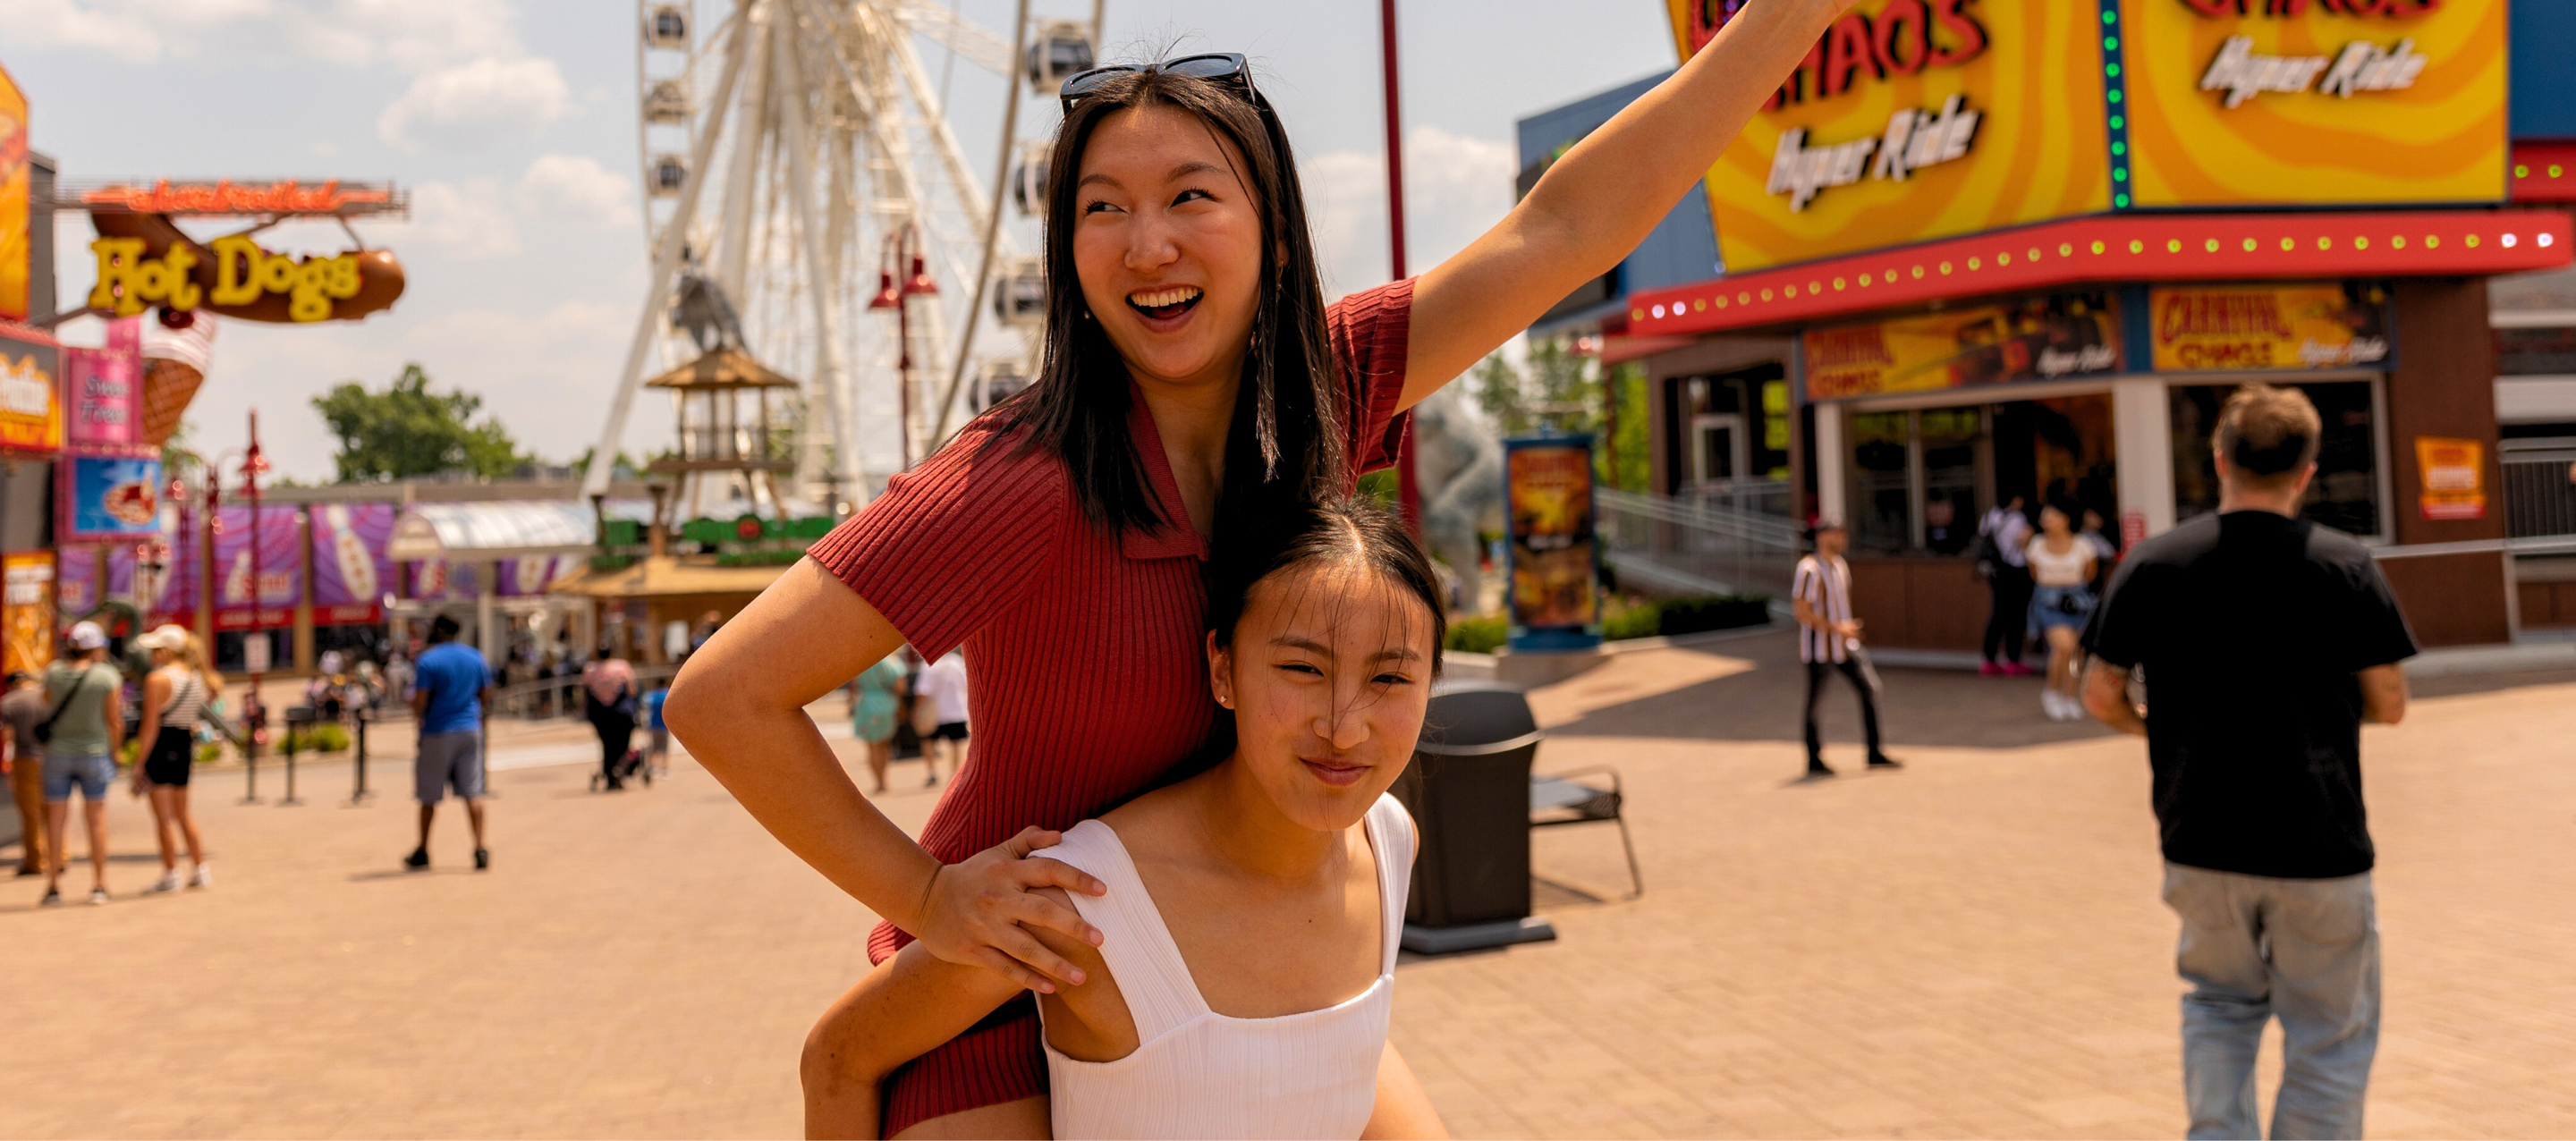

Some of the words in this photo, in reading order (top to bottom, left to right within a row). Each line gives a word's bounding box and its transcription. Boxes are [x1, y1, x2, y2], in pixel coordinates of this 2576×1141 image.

[1757, 0, 1985, 111] HAOS
[2202, 35, 2329, 108] Hyper
[2319, 38, 2429, 98] Ride
[1766, 126, 1877, 213] Hyper
[1873, 93, 1980, 182] Ride
[89, 235, 203, 317] Hot
[210, 232, 361, 323] Dogs
